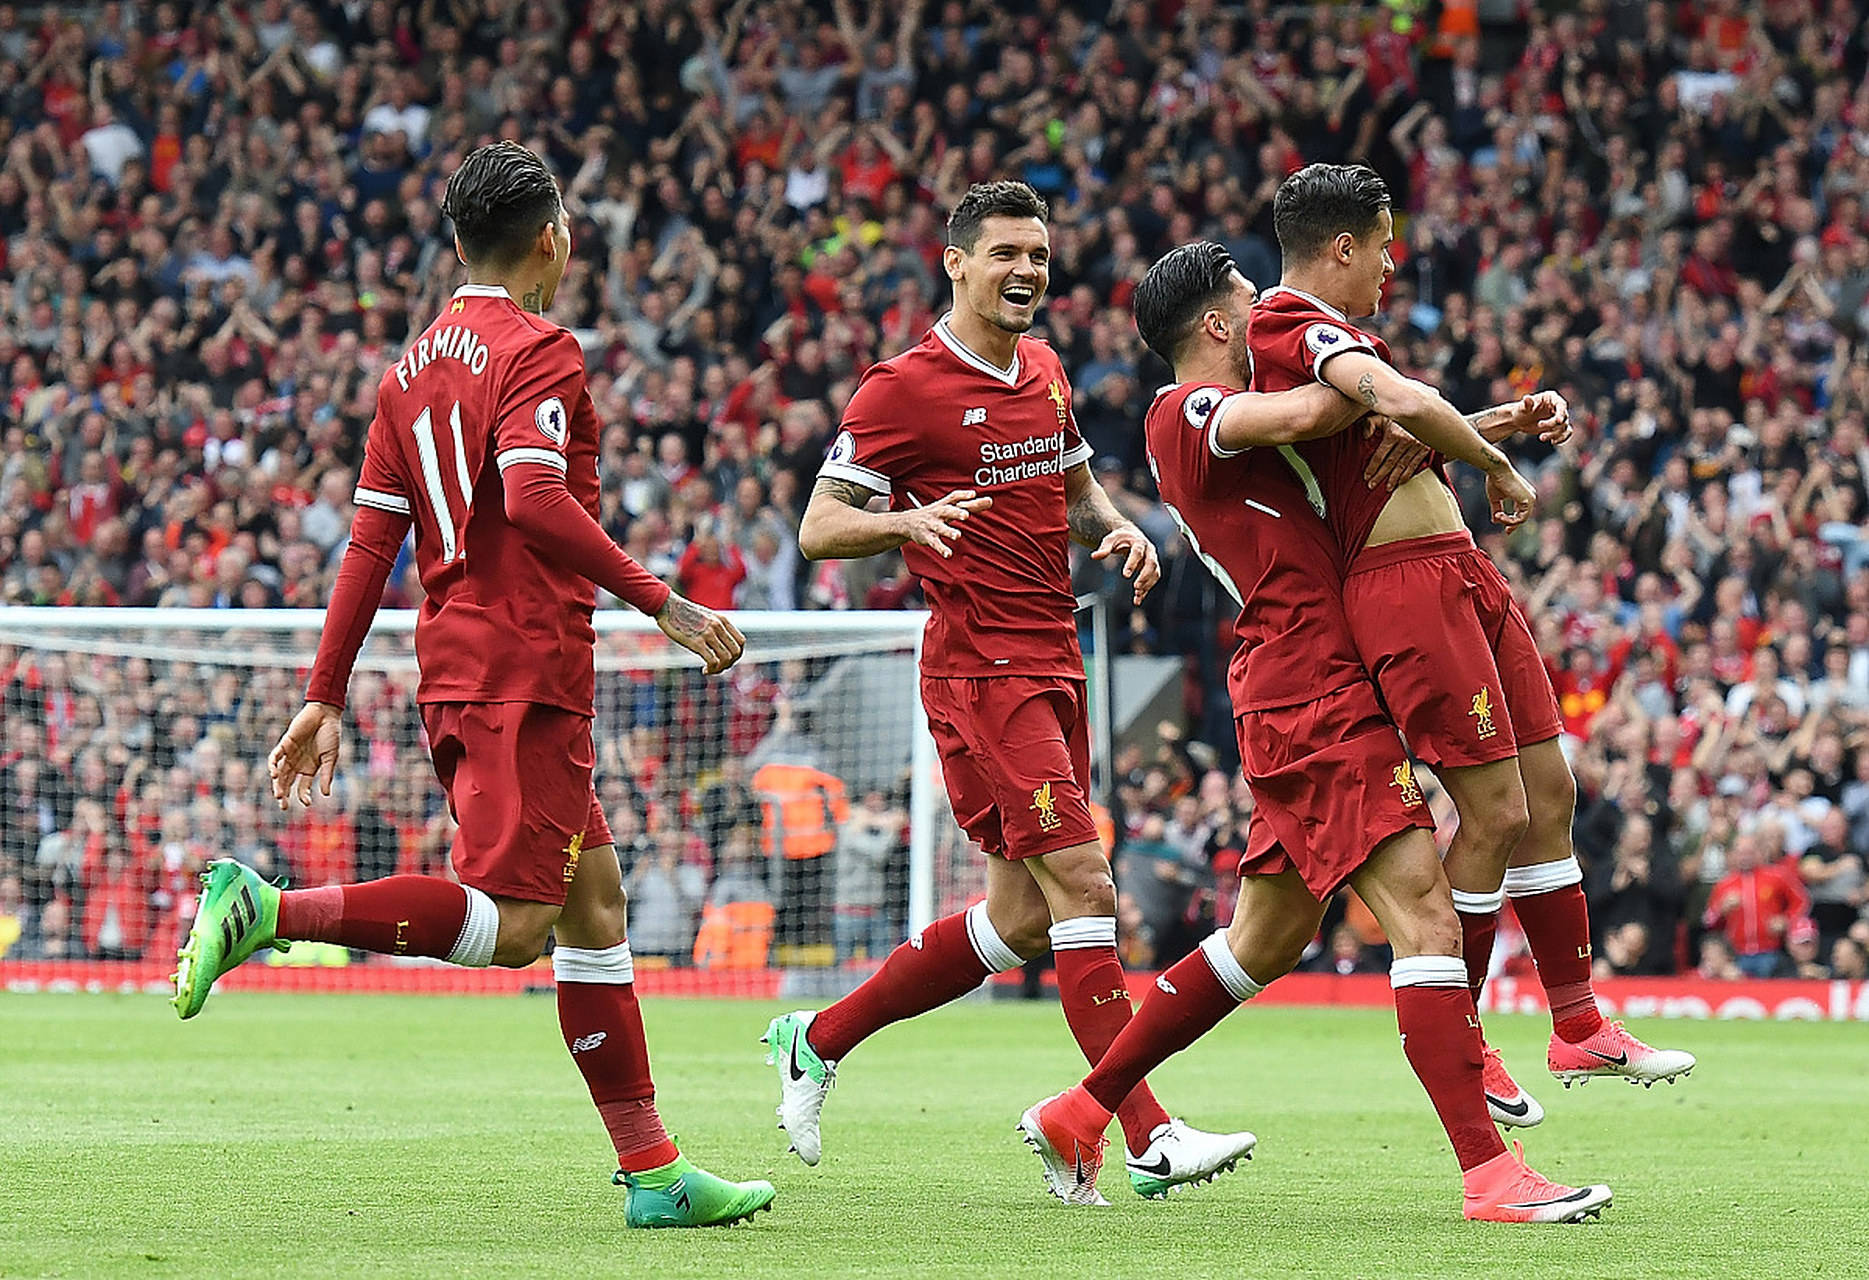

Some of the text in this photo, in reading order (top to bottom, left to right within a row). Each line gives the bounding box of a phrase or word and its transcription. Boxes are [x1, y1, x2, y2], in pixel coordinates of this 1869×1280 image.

[395, 325, 489, 392] FIRMINO
[975, 454, 1059, 487] Chartered
[980, 431, 1059, 463] Standard
[411, 399, 474, 565] 11
